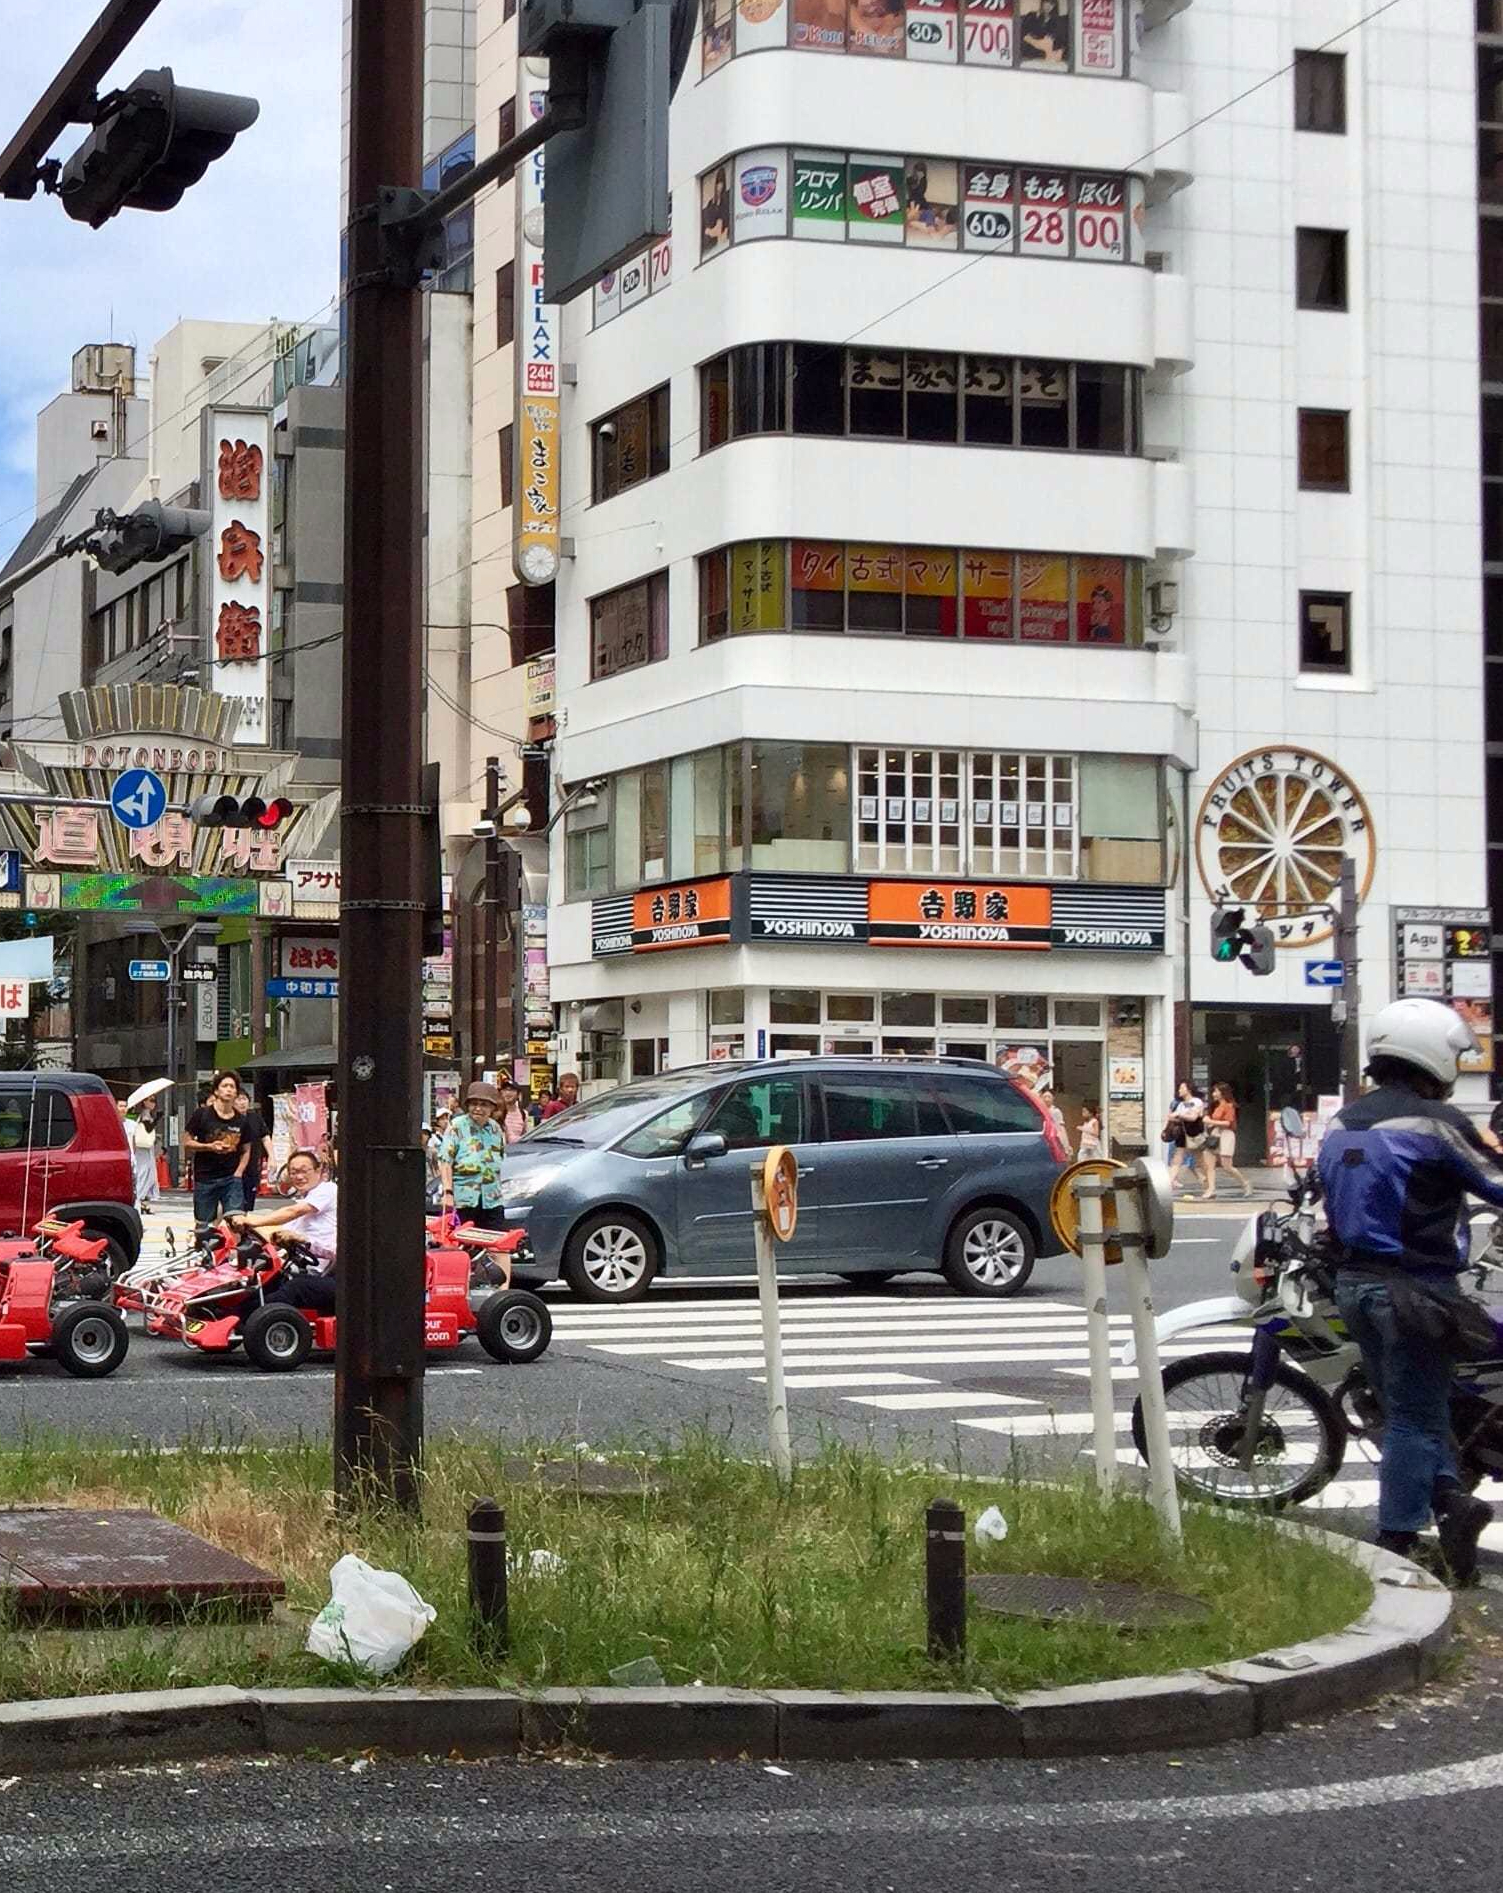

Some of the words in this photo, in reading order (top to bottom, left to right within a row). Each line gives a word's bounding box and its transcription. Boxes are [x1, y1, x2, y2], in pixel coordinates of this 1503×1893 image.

[795, 169, 840, 189] アロマ
[529, 364, 554, 380] 24H
[82, 745, 227, 773] DOTONBORI
[1203, 753, 1274, 828] FRUITS
[1294, 754, 1366, 833] TOWER
[651, 888, 700, 923] 吉野家
[920, 888, 1010, 922] 吉野家
[651, 924, 700, 943] YOSHINOYA
[763, 919, 856, 938] YOSHINOYA
[919, 924, 1010, 942] YOSHINOYA
[1064, 929, 1153, 947] YOSHINOYA
